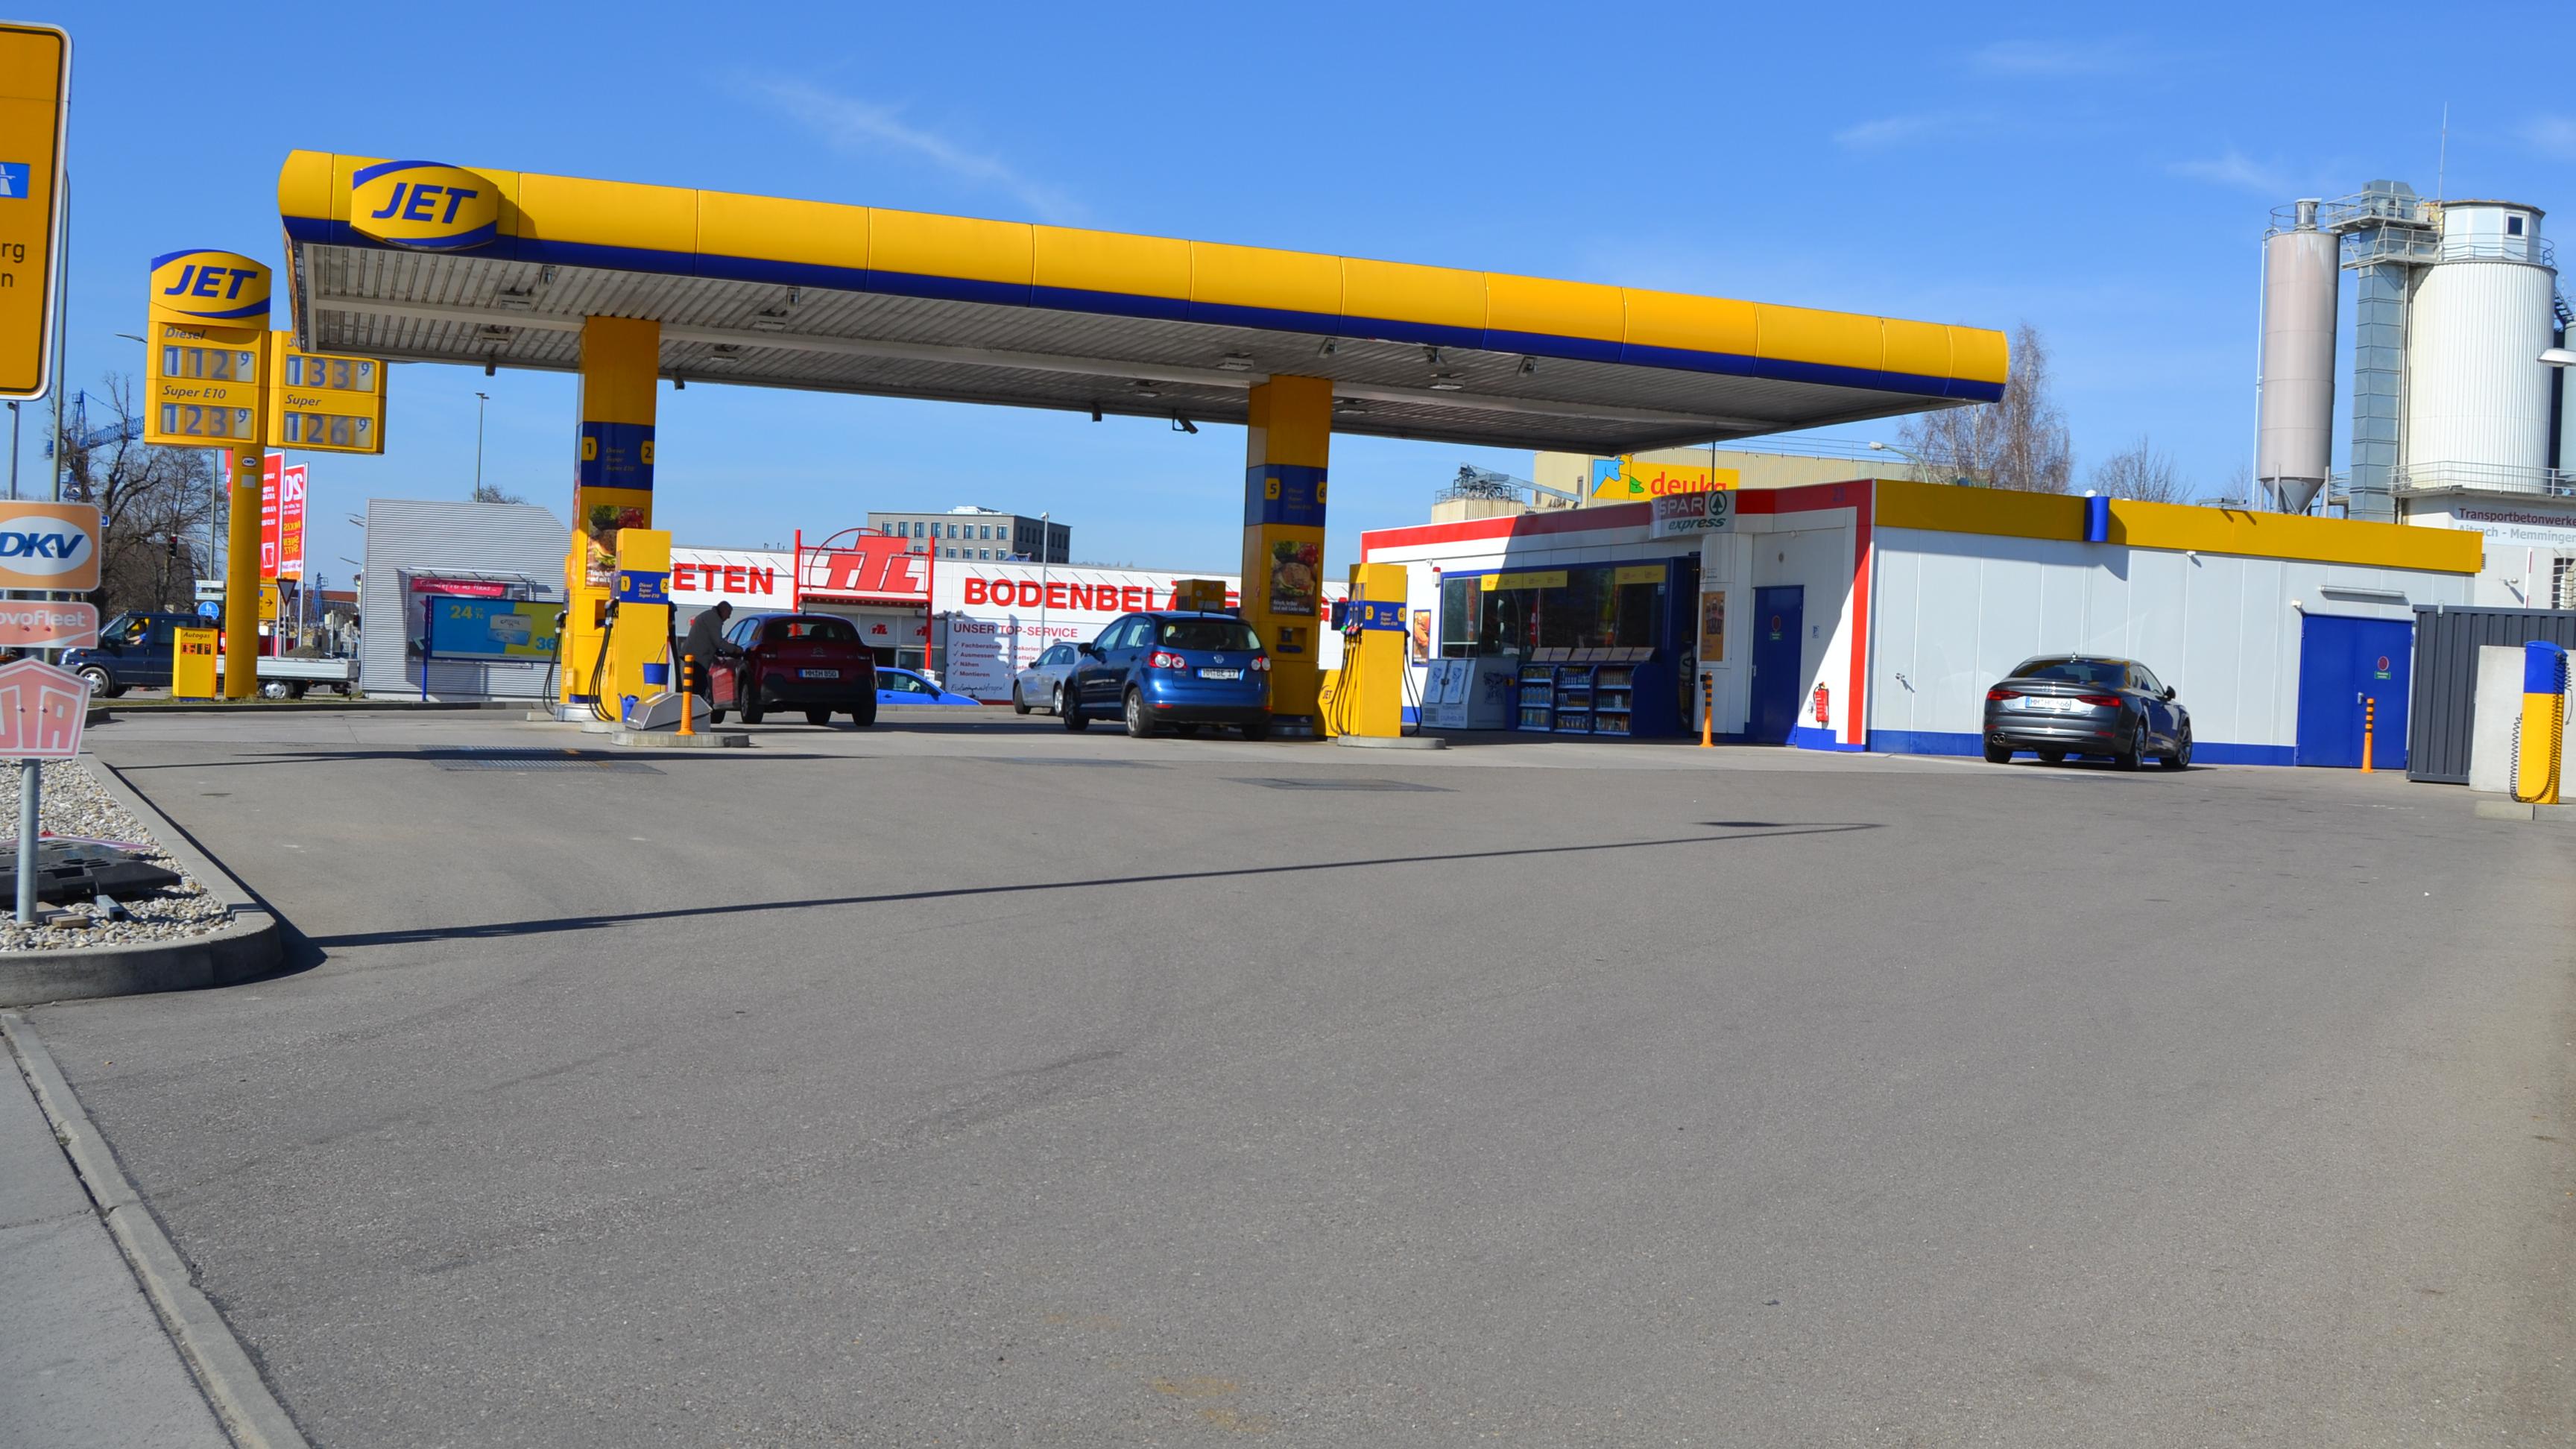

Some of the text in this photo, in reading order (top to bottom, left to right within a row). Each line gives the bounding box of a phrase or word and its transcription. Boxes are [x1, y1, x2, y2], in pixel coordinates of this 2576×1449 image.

[371, 182, 479, 224] JET
[163, 265, 258, 300] JET
[164, 326, 206, 340] Diesel
[162, 385, 227, 400] Super E10
[285, 394, 322, 408] Super
[586, 442, 652, 458] 1 2
[1658, 496, 1704, 516] SPAR
[1668, 517, 1727, 532] express
[0, 532, 85, 559] DKV
[183, 631, 210, 640] Autogas
[953, 623, 1078, 638] UNSER TOP-SERVICE
